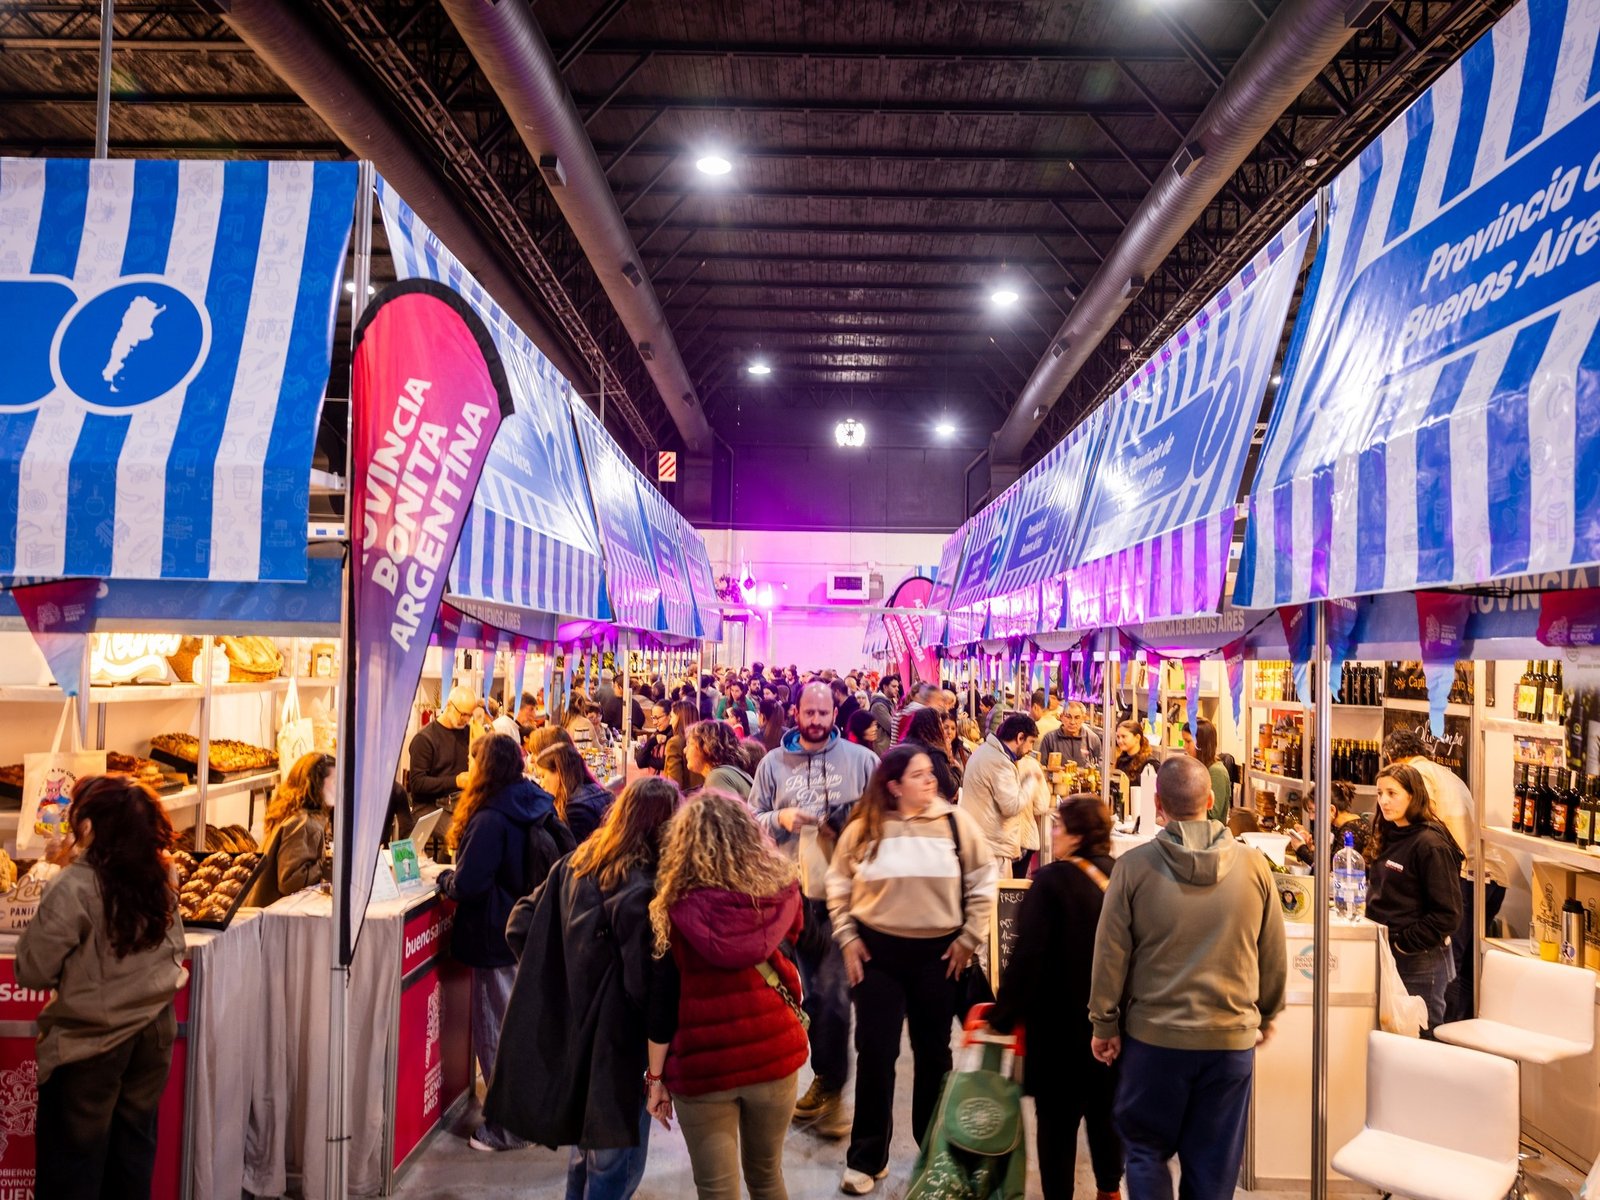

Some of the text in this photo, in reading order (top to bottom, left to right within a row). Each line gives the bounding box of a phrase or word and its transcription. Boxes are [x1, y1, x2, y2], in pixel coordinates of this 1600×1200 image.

[1403, 209, 1600, 349] Buenos Aire
[1420, 165, 1582, 294] Provincia
[362, 377, 432, 566] OVINCIA
[371, 420, 448, 597] BONITA
[390, 401, 490, 653] ARGENTINA
[1143, 610, 1245, 639] PROVINCIA DE BUENOS AIRES
[10, 907, 35, 917] PANIF
